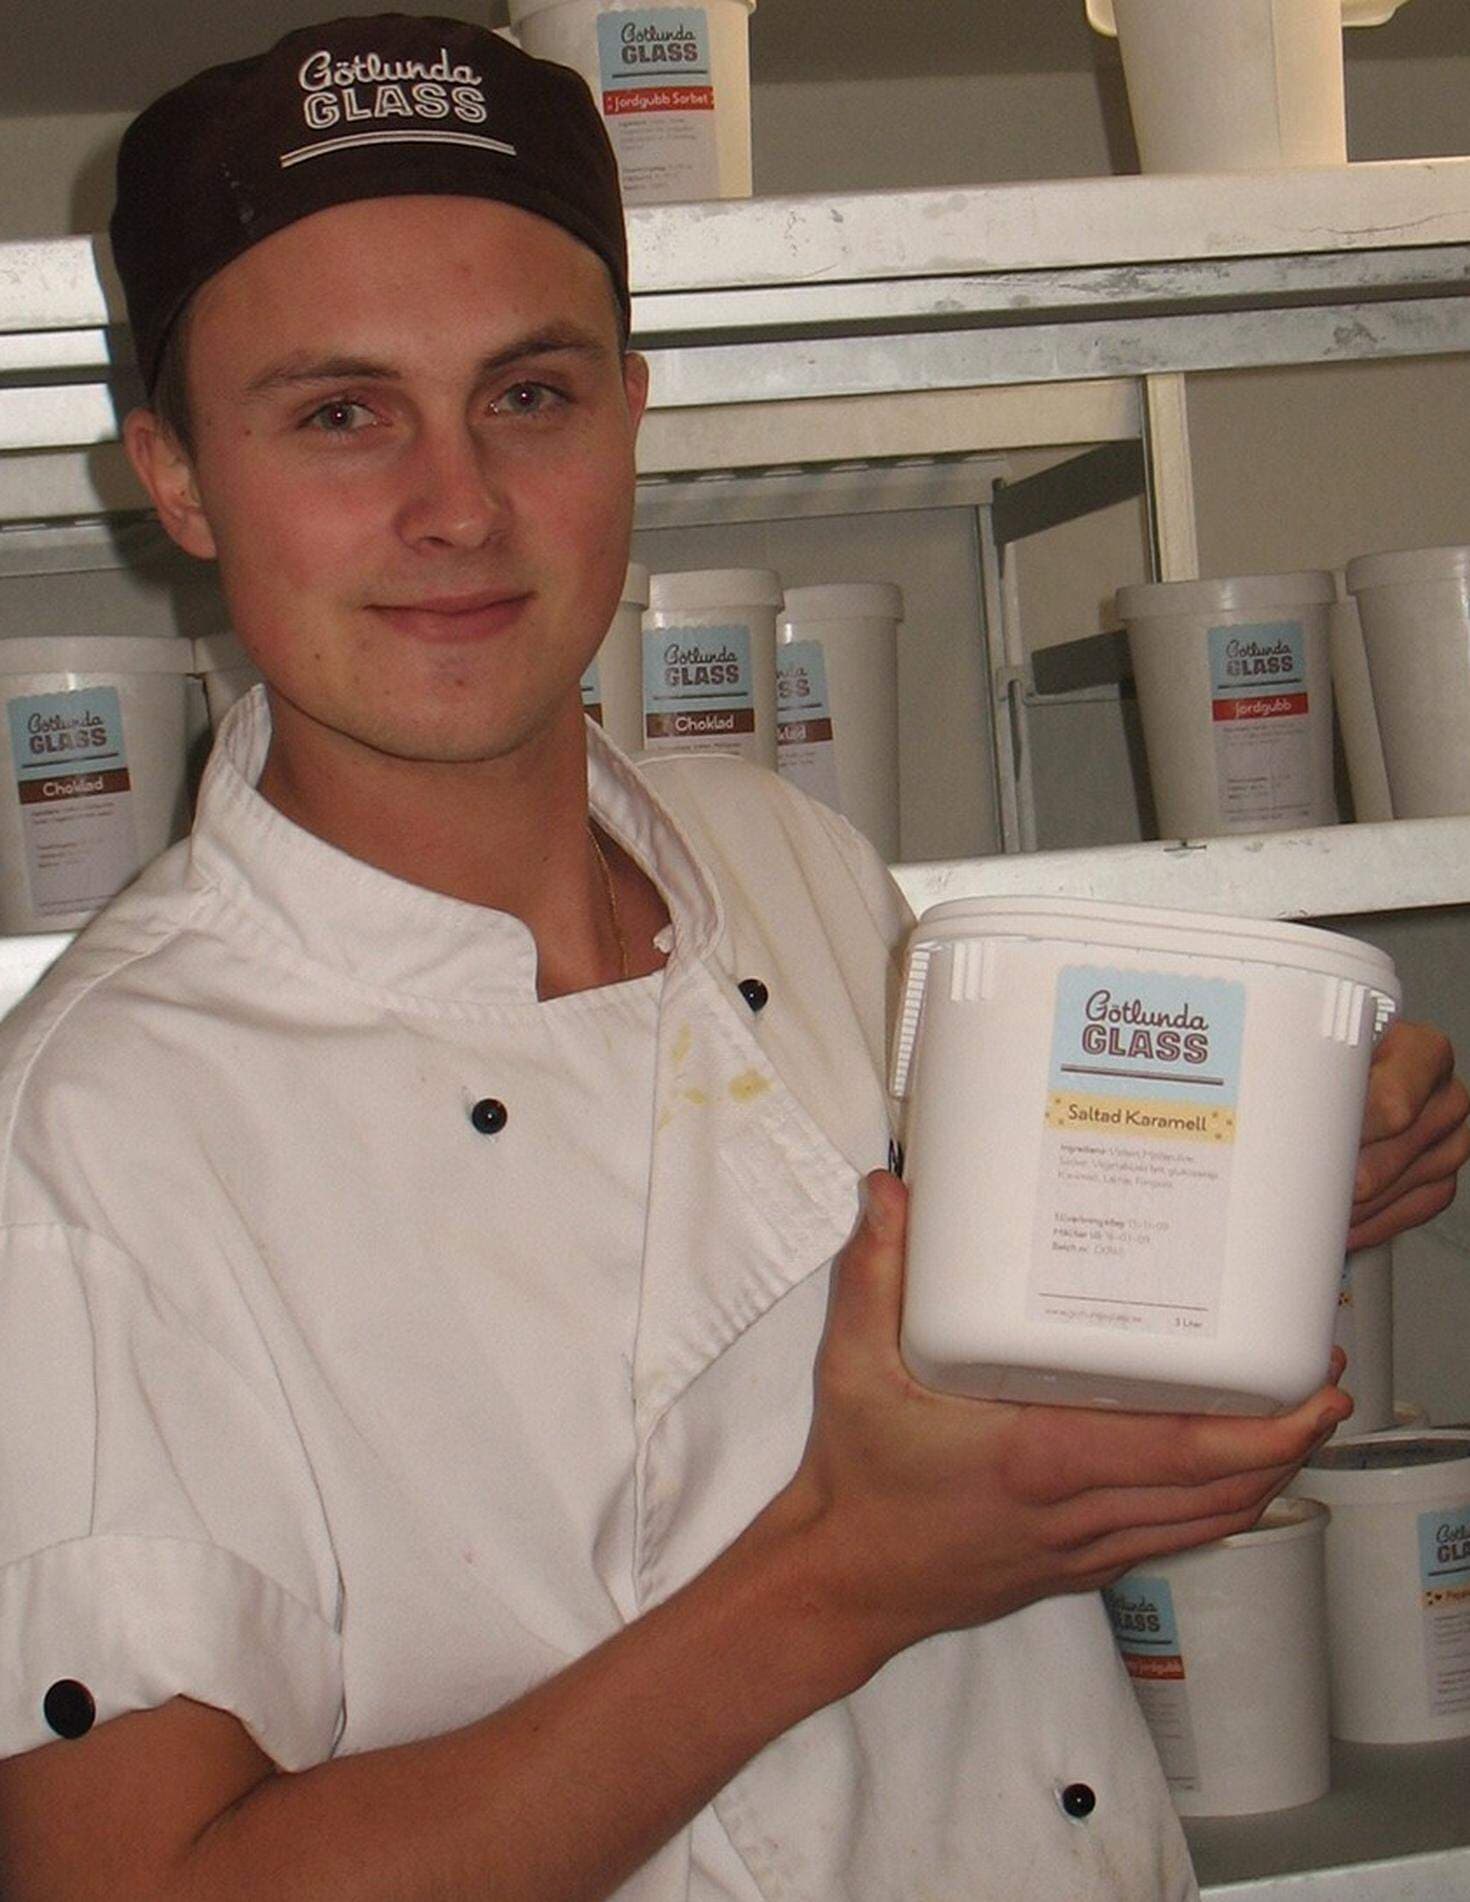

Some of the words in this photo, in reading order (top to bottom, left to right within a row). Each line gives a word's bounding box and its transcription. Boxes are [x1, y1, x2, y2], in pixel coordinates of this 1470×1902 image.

[622, 44, 697, 63] GLASS
[304, 83, 487, 129] GLASS
[615, 93, 670, 110] Jordgubb
[674, 92, 707, 105] Sorbet
[665, 664, 739, 686] GLASS
[1227, 656, 1293, 676] GLASS
[676, 714, 733, 731] Choklad
[29, 727, 107, 754] GLASS
[43, 777, 103, 797] Choklad
[1082, 1025, 1209, 1064] GLASS
[1068, 1105, 1121, 1124] Saltad
[1126, 1110, 1208, 1132] Karamell
